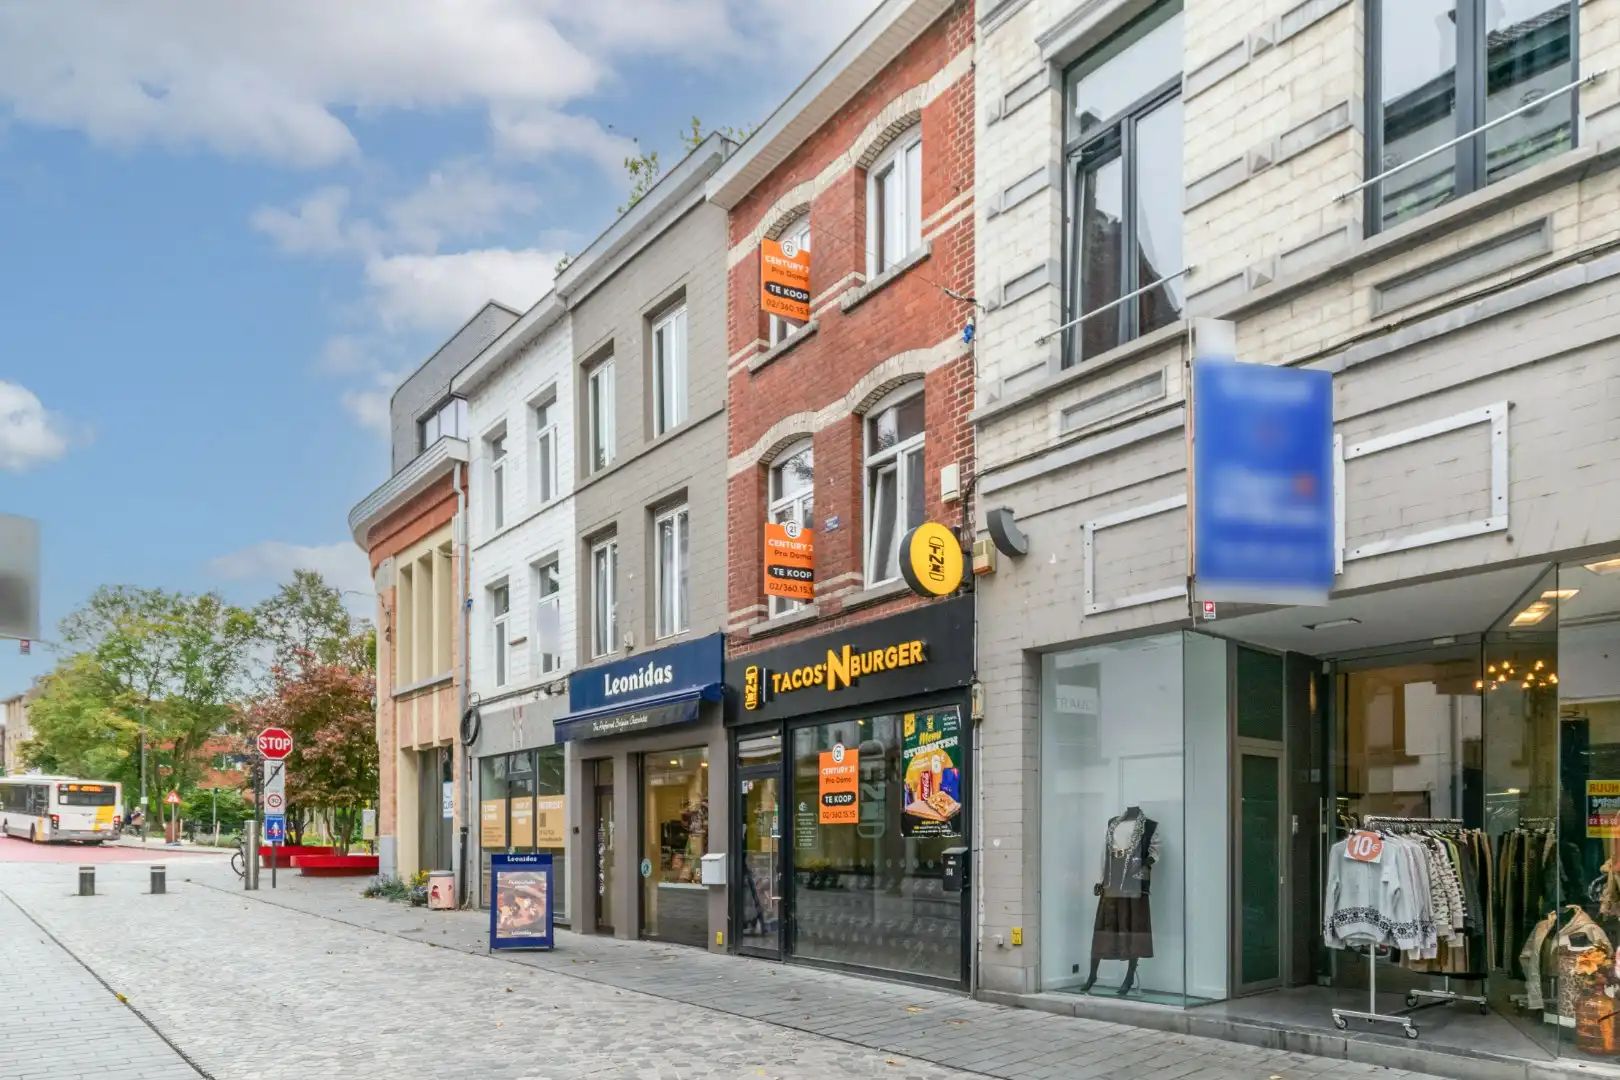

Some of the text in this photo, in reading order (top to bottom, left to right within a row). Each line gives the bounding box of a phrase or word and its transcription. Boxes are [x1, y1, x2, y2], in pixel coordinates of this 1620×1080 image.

[765, 255, 804, 271] CENTURY
[771, 266, 784, 275] Pro
[769, 284, 808, 300] TE KOOP
[766, 299, 809, 316] 02/360.15.1
[768, 539, 807, 551] CENTURY
[773, 567, 812, 579] TE KOOP
[769, 582, 813, 594] 02/360.15.1
[604, 661, 673, 696] Leonidas
[260, 736, 291, 751] STOP
[919, 730, 942, 745] Menu
[822, 767, 848, 776] CENTURY
[825, 795, 852, 804] TE KOOP
